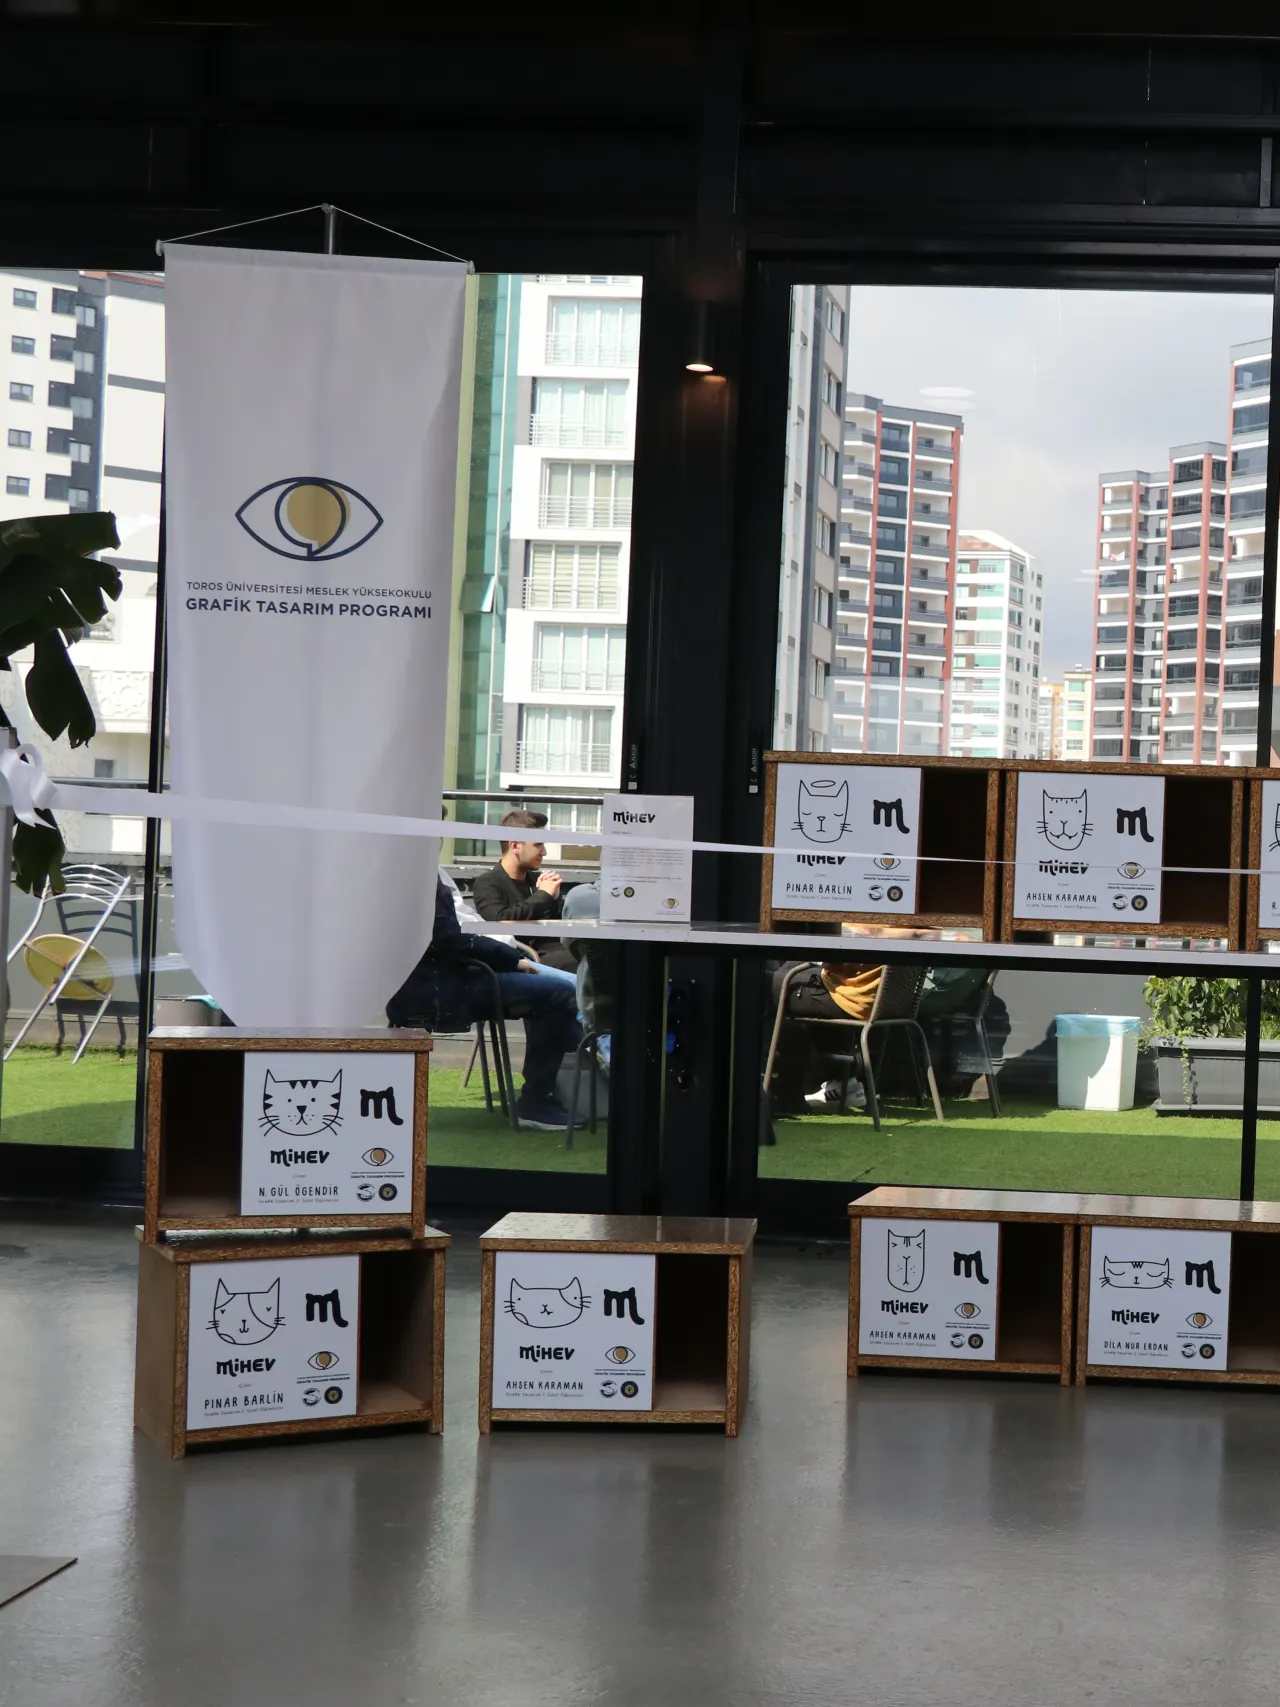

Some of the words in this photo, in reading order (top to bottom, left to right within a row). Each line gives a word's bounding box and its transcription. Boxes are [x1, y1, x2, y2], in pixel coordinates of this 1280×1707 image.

[187, 581, 223, 591] TOROS
[226, 581, 303, 594] ÜNİVERSİTESİ
[306, 587, 349, 596] MESLEK
[352, 586, 432, 599] YÜKSEKOKULU
[186, 597, 251, 613] GRAFİK
[256, 600, 334, 616] TASARIM
[339, 603, 432, 619] PROGRAMI
[786, 882, 814, 893] PINAR
[819, 882, 852, 894] BARLİN
[1026, 892, 1052, 901] AHSEN
[1056, 894, 1097, 903] KARAMAN
[271, 1185, 289, 1197] GÜL
[870, 1330, 893, 1339] AHSEN
[897, 1331, 936, 1340] KARAMAN
[1125, 1341, 1140, 1350] NUR
[1143, 1342, 1168, 1351] ERDAN
[506, 1380, 534, 1390] AHSEN
[538, 1381, 583, 1390] KARAMAN
[204, 1396, 238, 1410] PINAR
[244, 1391, 284, 1407] BARLİN
